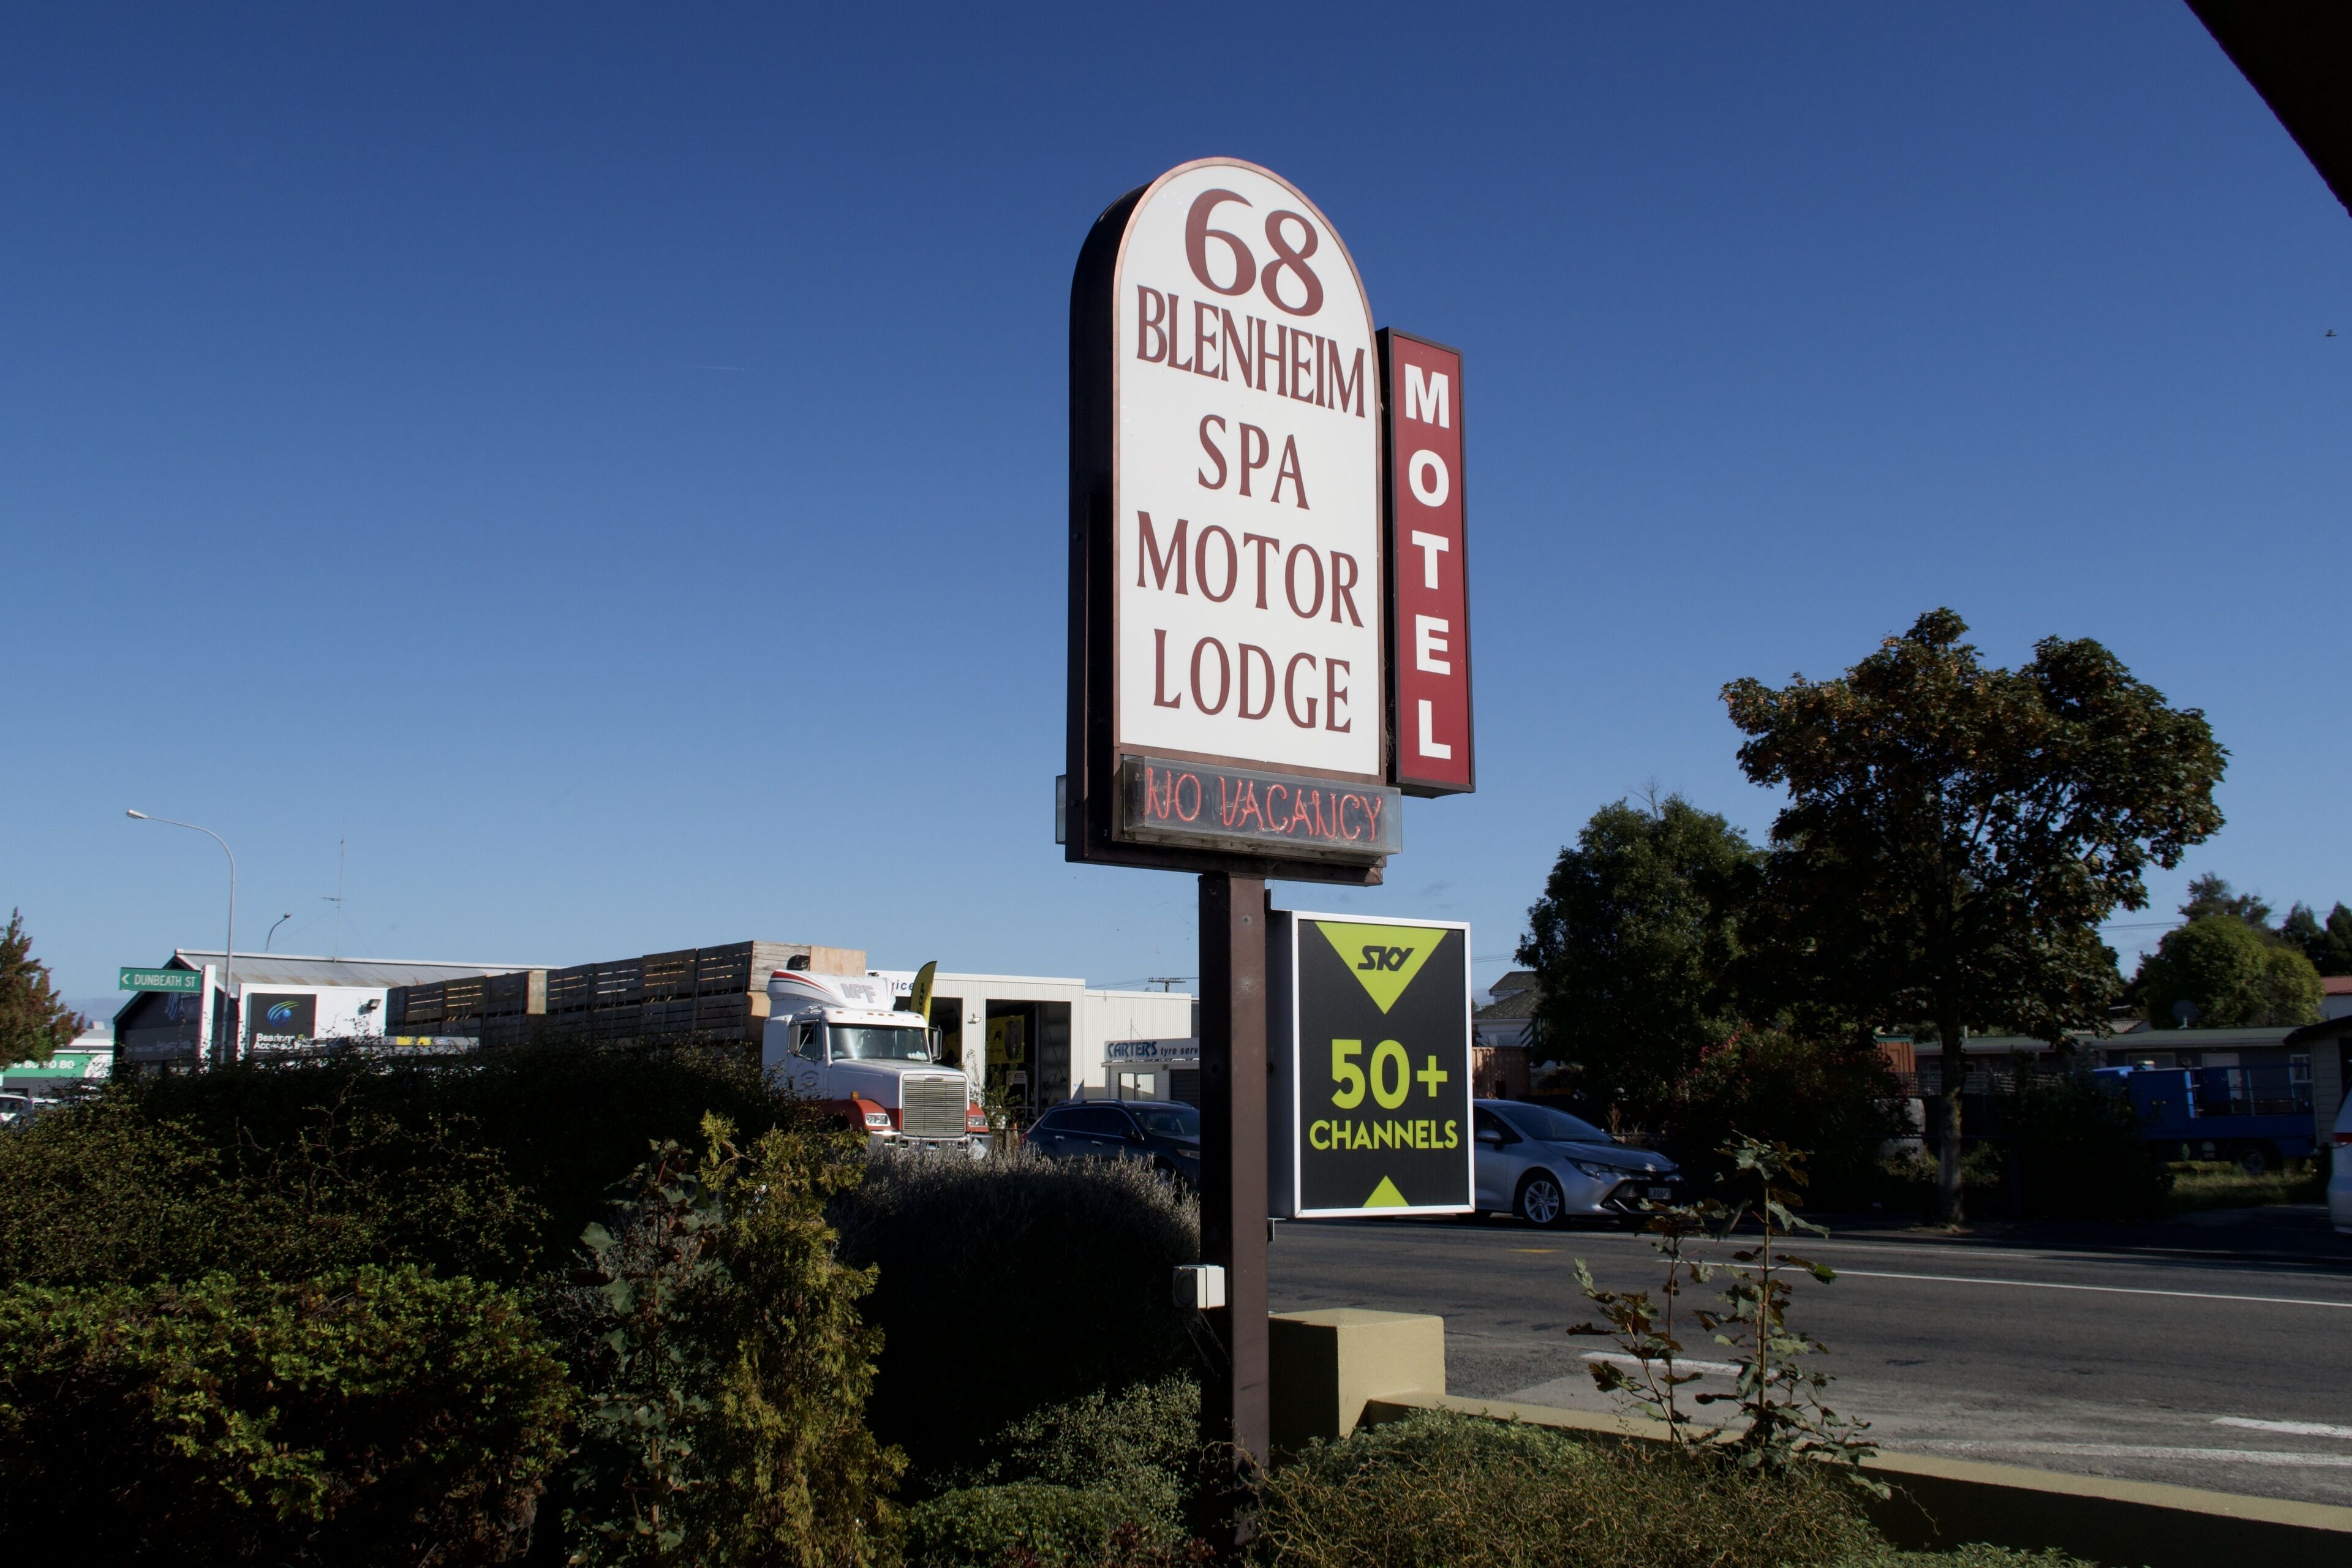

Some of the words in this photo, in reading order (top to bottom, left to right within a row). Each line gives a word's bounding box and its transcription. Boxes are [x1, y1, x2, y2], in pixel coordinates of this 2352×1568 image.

[1185, 188, 1324, 317] 68
[1136, 284, 1366, 418] BLENHEIM
[1198, 414, 1311, 510] SPA
[1136, 510, 1365, 628] MOTOR
[1404, 363, 1451, 760] MOTEL
[1153, 628, 1351, 734] LODGE
[1143, 766, 1201, 822] NO
[1219, 775, 1382, 843] VACANCY
[134, 974, 182, 987] DUNBEATH
[185, 976, 196, 987] ST
[1357, 945, 1415, 971] SKY
[59, 1060, 75, 1069] 80
[1107, 1041, 1158, 1058] CARTER'S
[1161, 1047, 1177, 1057] tyre
[1331, 1039, 1448, 1109] 50+
[1310, 1119, 1458, 1150] CHANNELS
